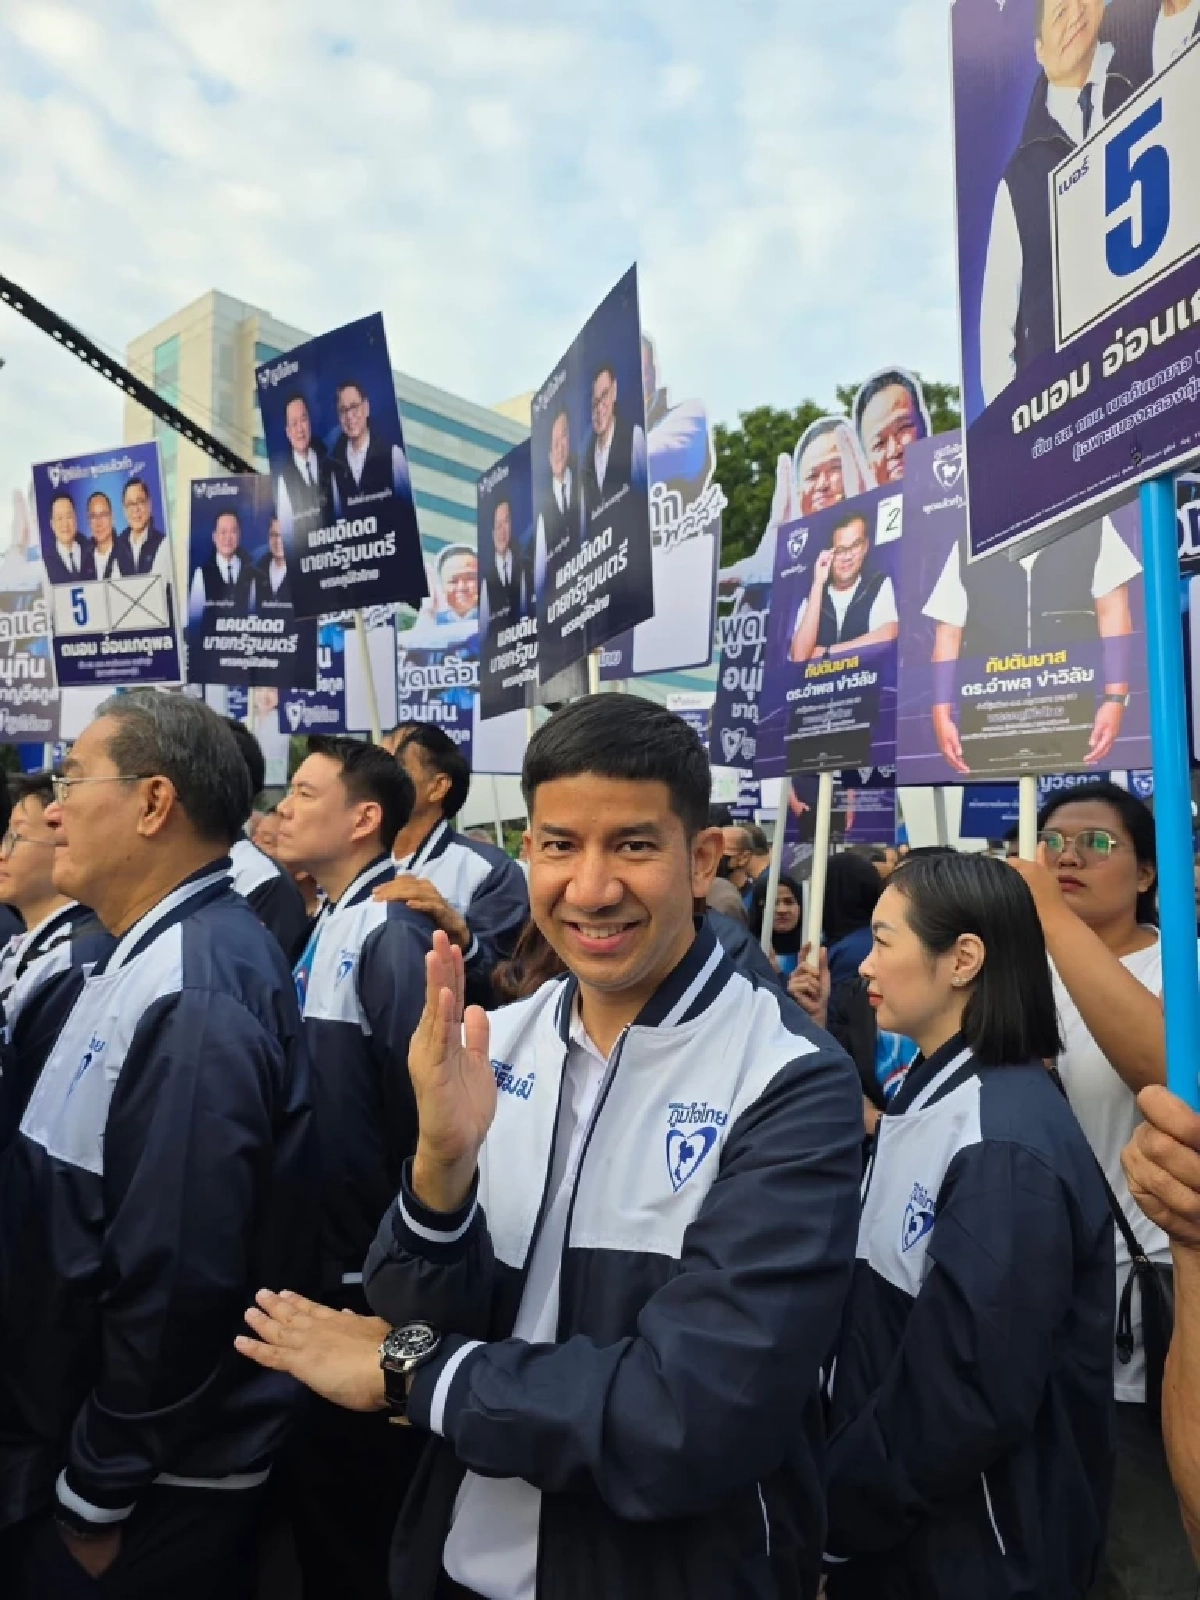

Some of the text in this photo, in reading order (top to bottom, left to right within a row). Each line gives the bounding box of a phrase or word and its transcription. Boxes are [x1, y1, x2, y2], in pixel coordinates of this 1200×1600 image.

[1058, 155, 1090, 195] เบอร์
[1104, 96, 1171, 277] 5
[1011, 361, 1091, 434] ถนอม
[307, 516, 377, 548] แคนดิเดต
[885, 507, 901, 532] 2
[301, 531, 396, 573] นายกรัฐมนตรี
[555, 527, 613, 589] แคนดิเดต
[547, 537, 629, 623] นายกรัฐมนตรี
[70, 586, 88, 626] 5
[215, 614, 284, 633] แคนดิเดต
[61, 641, 98, 657] ถนอม
[203, 633, 299, 655] นายกรัฐมนตรี
[985, 650, 1067, 673] กัปตันยาส
[961, 666, 1095, 696] ดร.อำพล ขำวิลัย
[667, 1102, 728, 1127] ภูมิใจไทย
